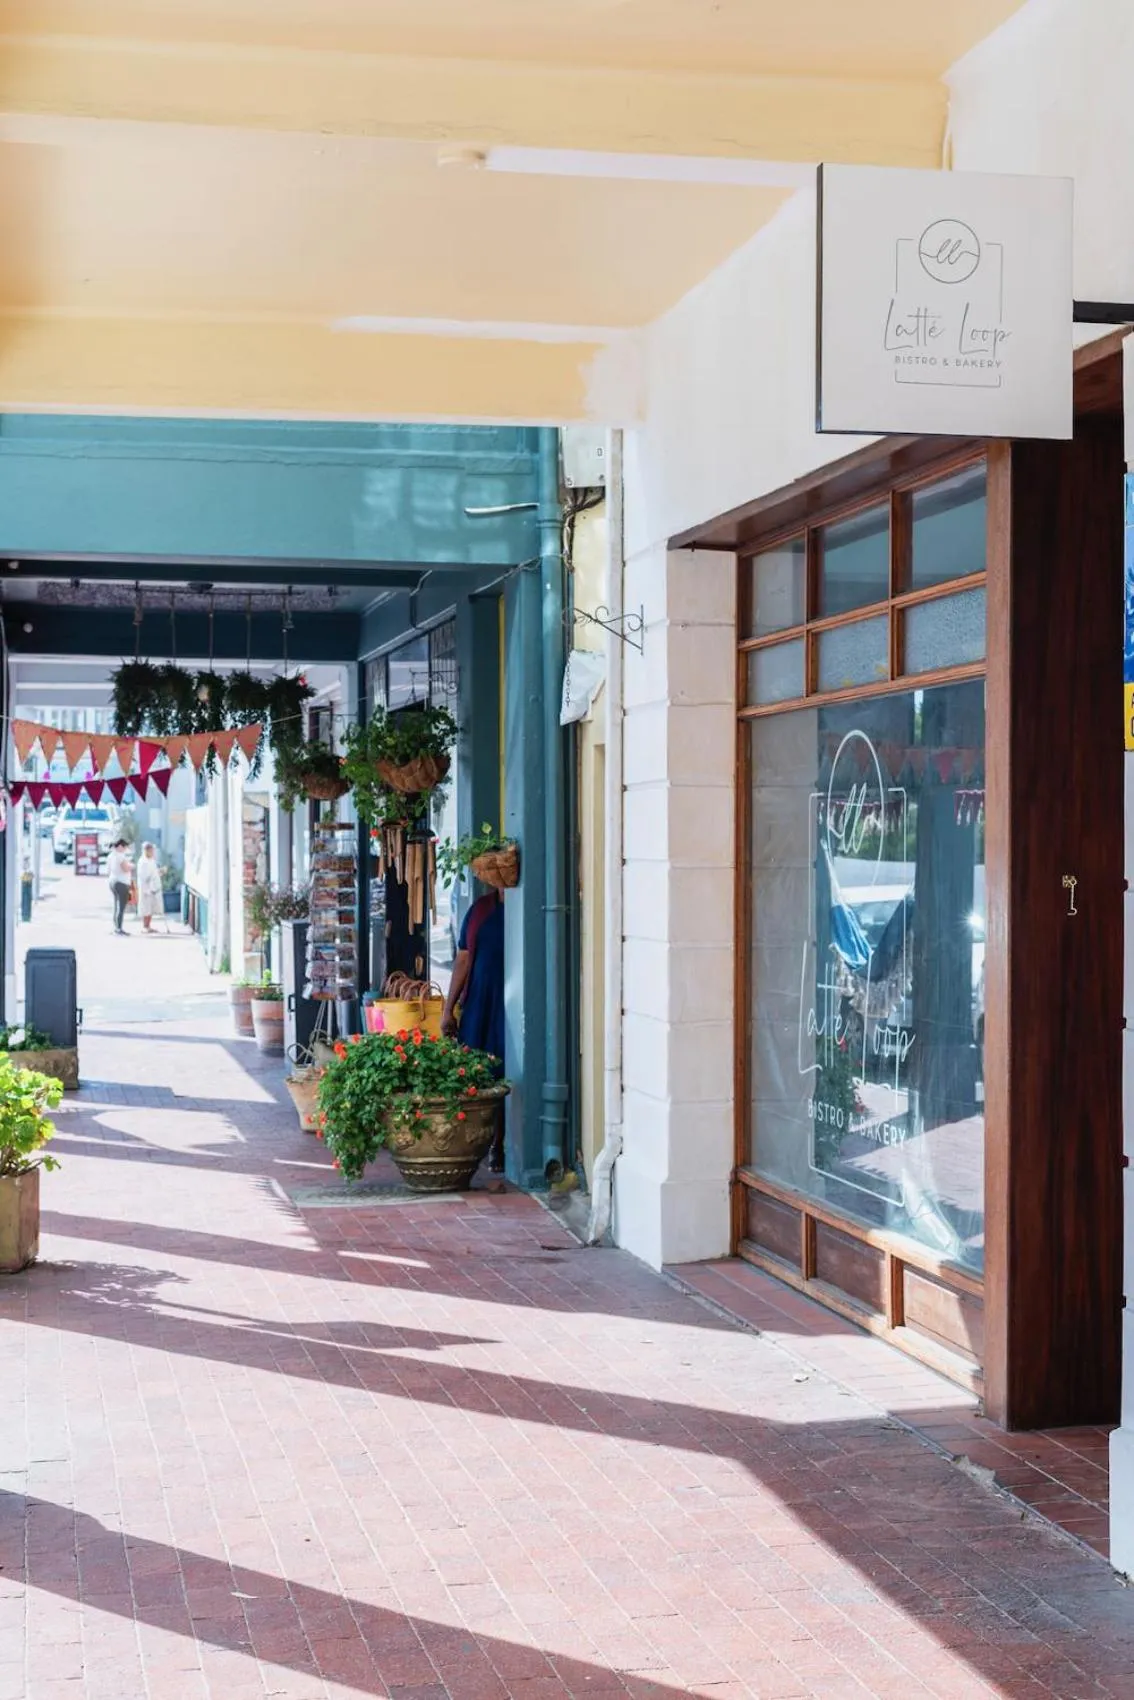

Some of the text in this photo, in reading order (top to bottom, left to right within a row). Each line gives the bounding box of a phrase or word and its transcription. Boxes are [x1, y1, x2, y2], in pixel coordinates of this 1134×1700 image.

[958, 302, 1012, 358] Loop
[895, 355, 1002, 368] BISTRO & BAKERY
[862, 950, 916, 1111] Loop
[807, 1098, 844, 1129] BISTRO
[860, 1115, 906, 1151] BAKERY
